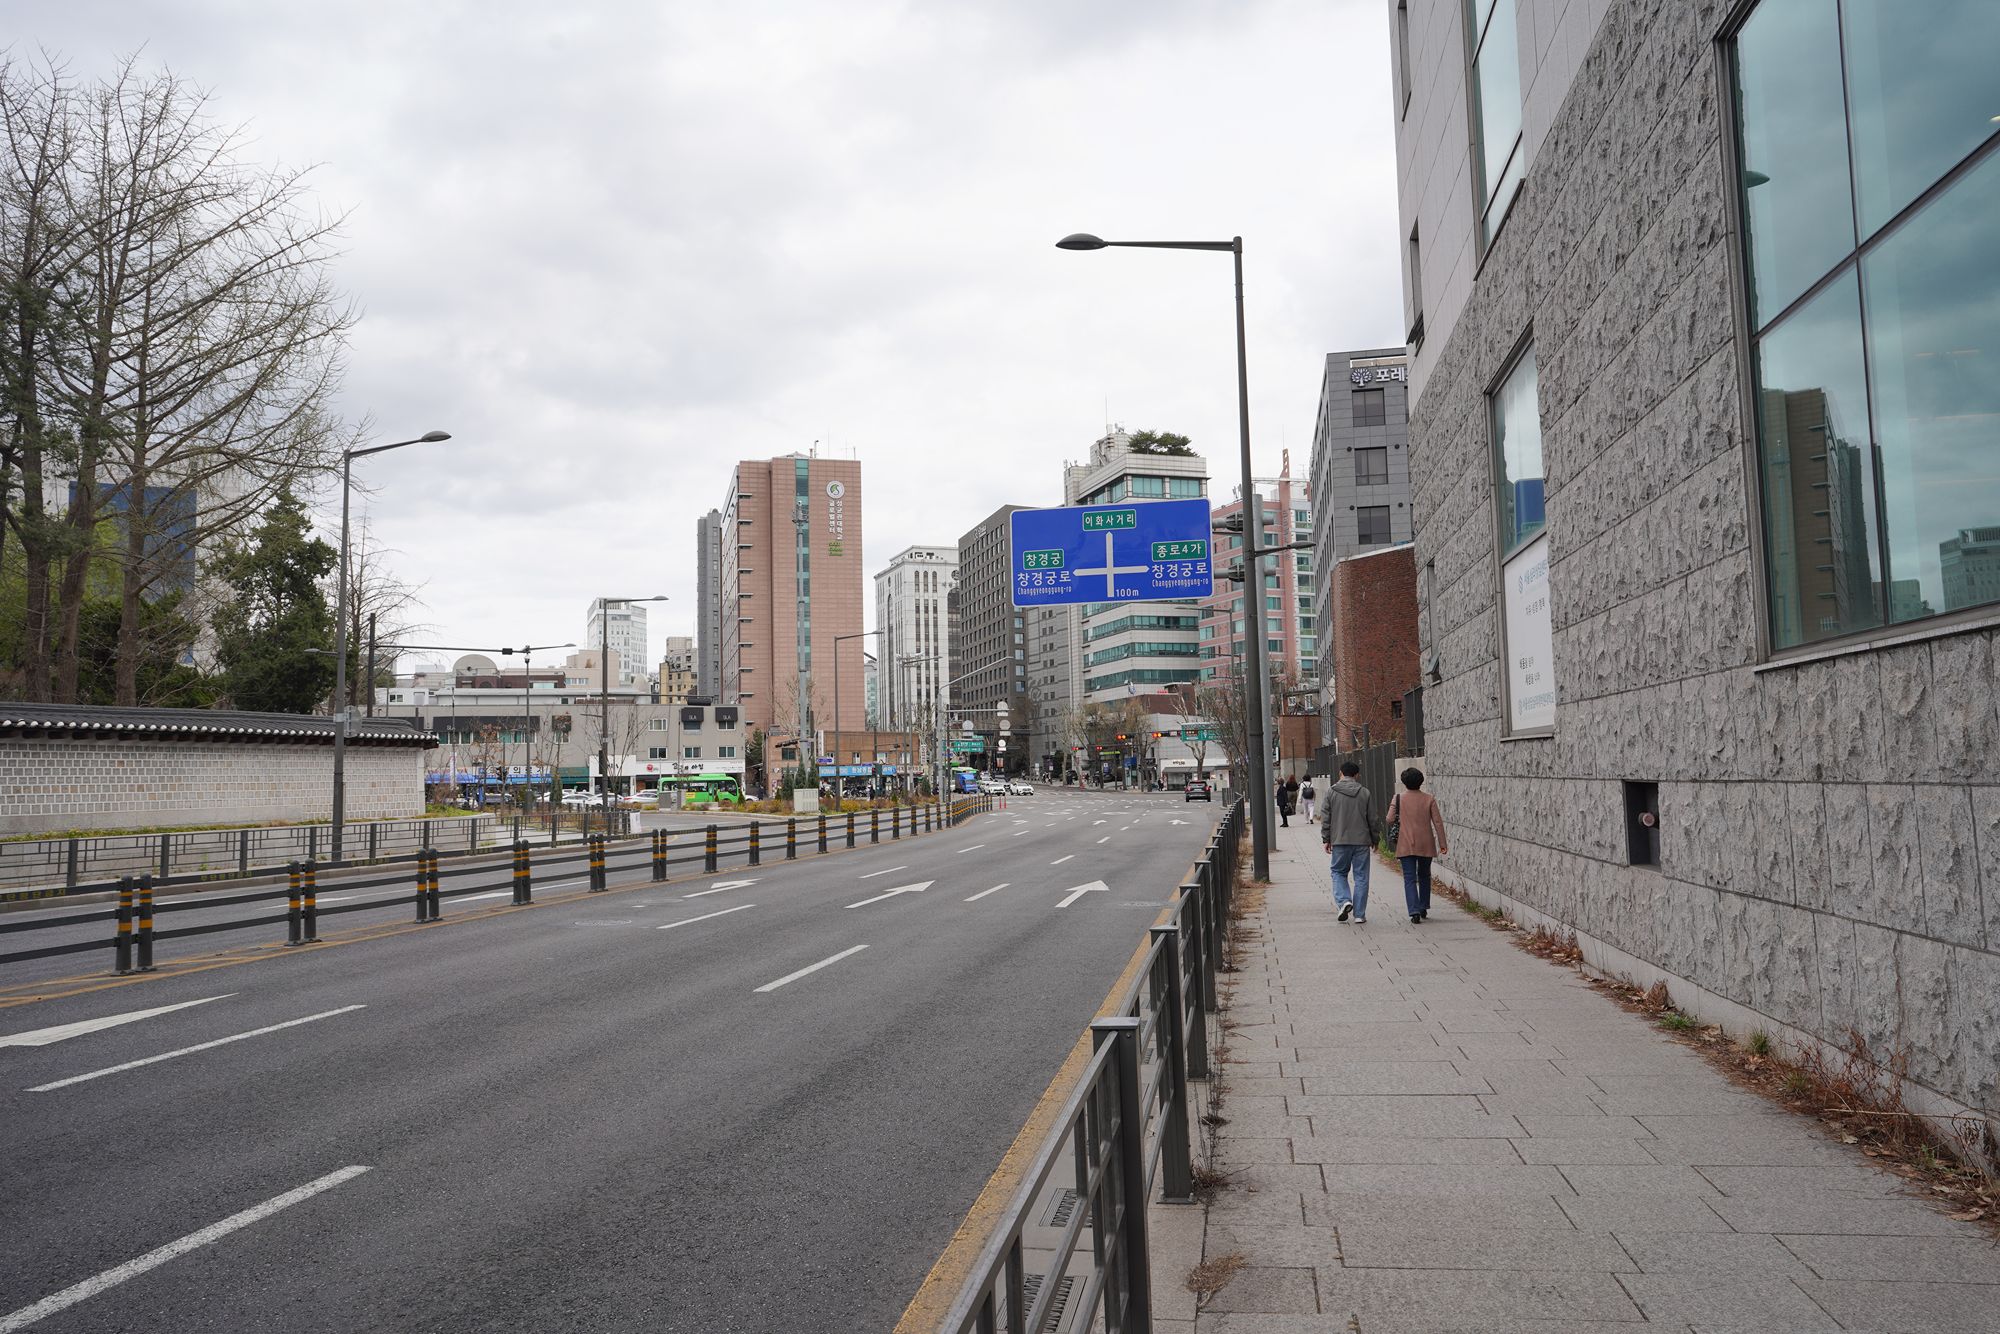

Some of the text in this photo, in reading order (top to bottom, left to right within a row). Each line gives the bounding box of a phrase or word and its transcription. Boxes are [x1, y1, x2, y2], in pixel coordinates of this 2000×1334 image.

[1375, 367, 1408, 382] 포레
[1084, 513, 1135, 527] 이화사거리
[1156, 543, 1202, 558] 종로4가
[1025, 552, 1062, 567] 창경궁
[1151, 562, 1209, 579] 창경궁로
[1017, 570, 1072, 587] 창경궁로
[1151, 578, 1209, 588] Changgyeonggung-ro
[1017, 585, 1072, 597] Changgyeonggung-ro
[1115, 588, 1139, 597] 100m
